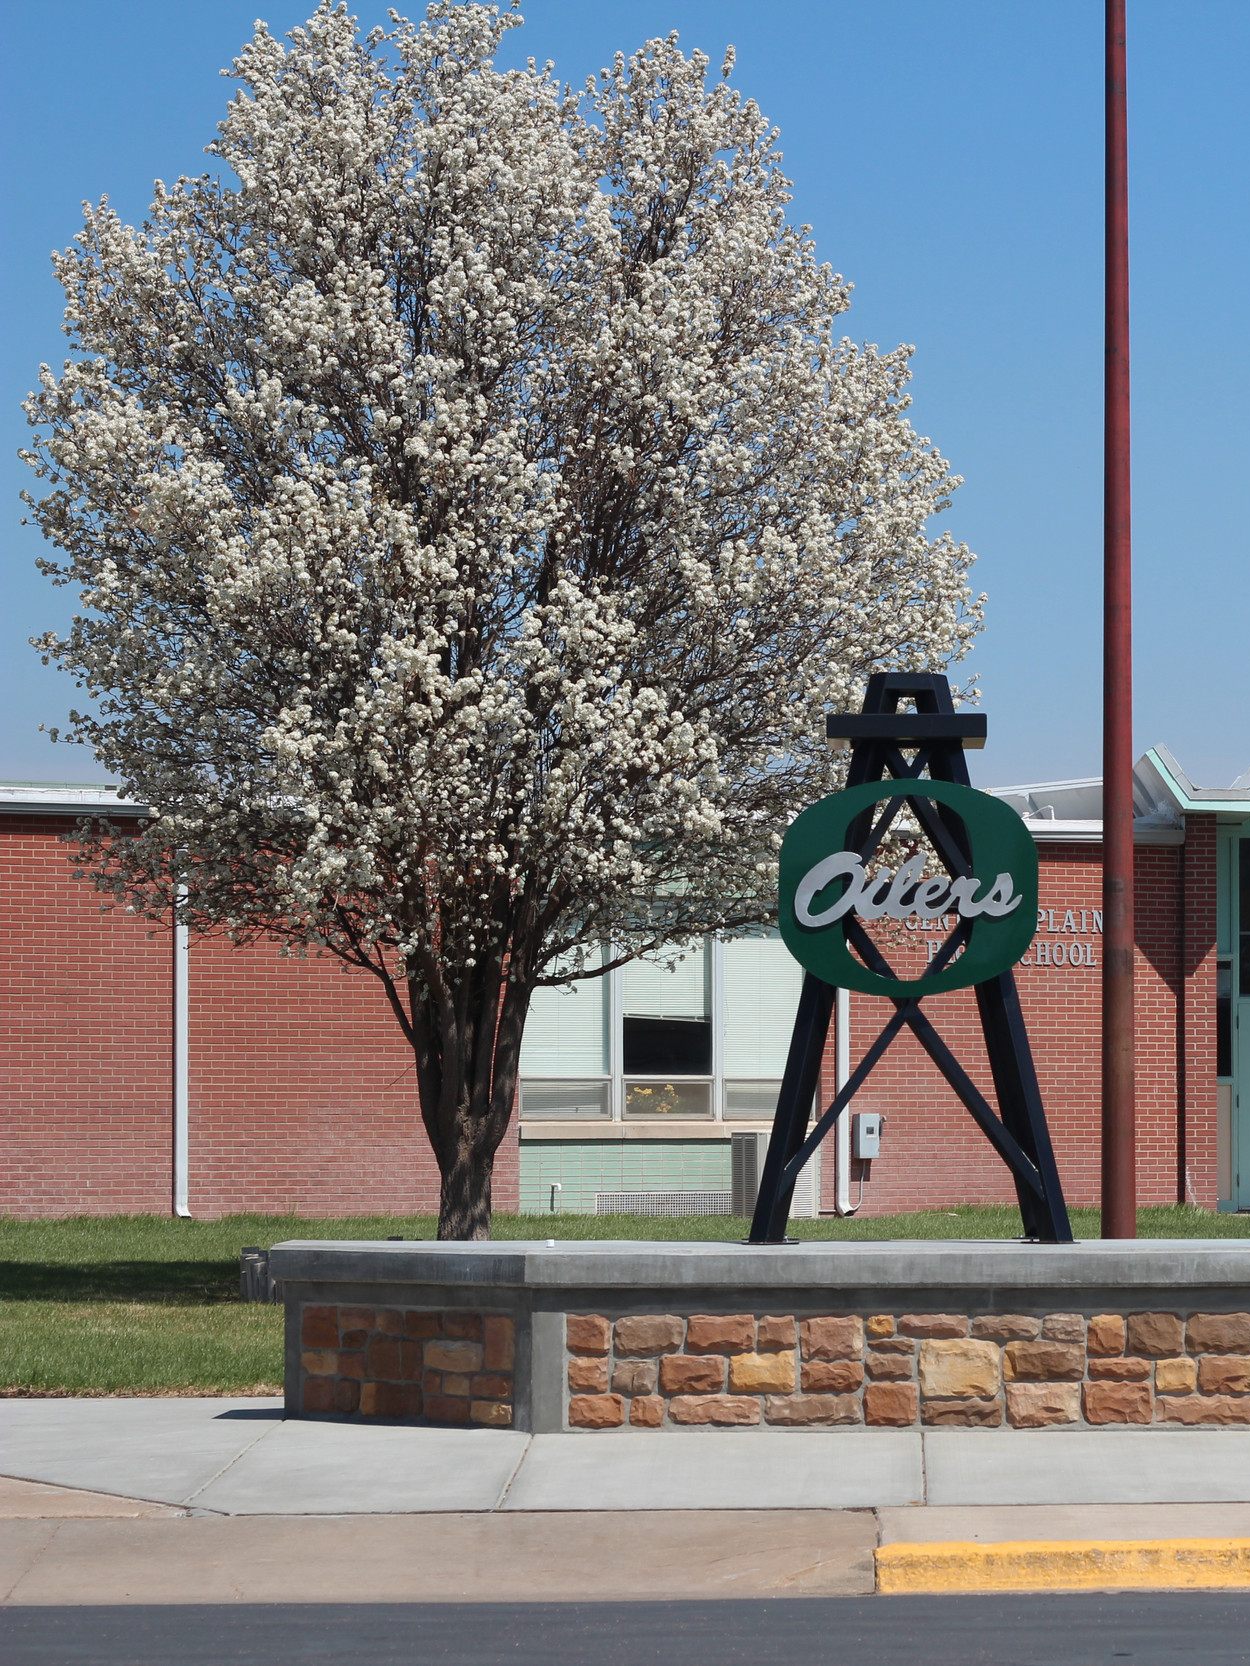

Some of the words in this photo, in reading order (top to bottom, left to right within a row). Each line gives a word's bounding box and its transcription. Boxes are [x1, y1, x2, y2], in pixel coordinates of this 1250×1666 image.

[794, 851, 1023, 928] Oilers
[1036, 909, 1103, 933] PLAIN
[1020, 942, 1097, 967] CHOOL
